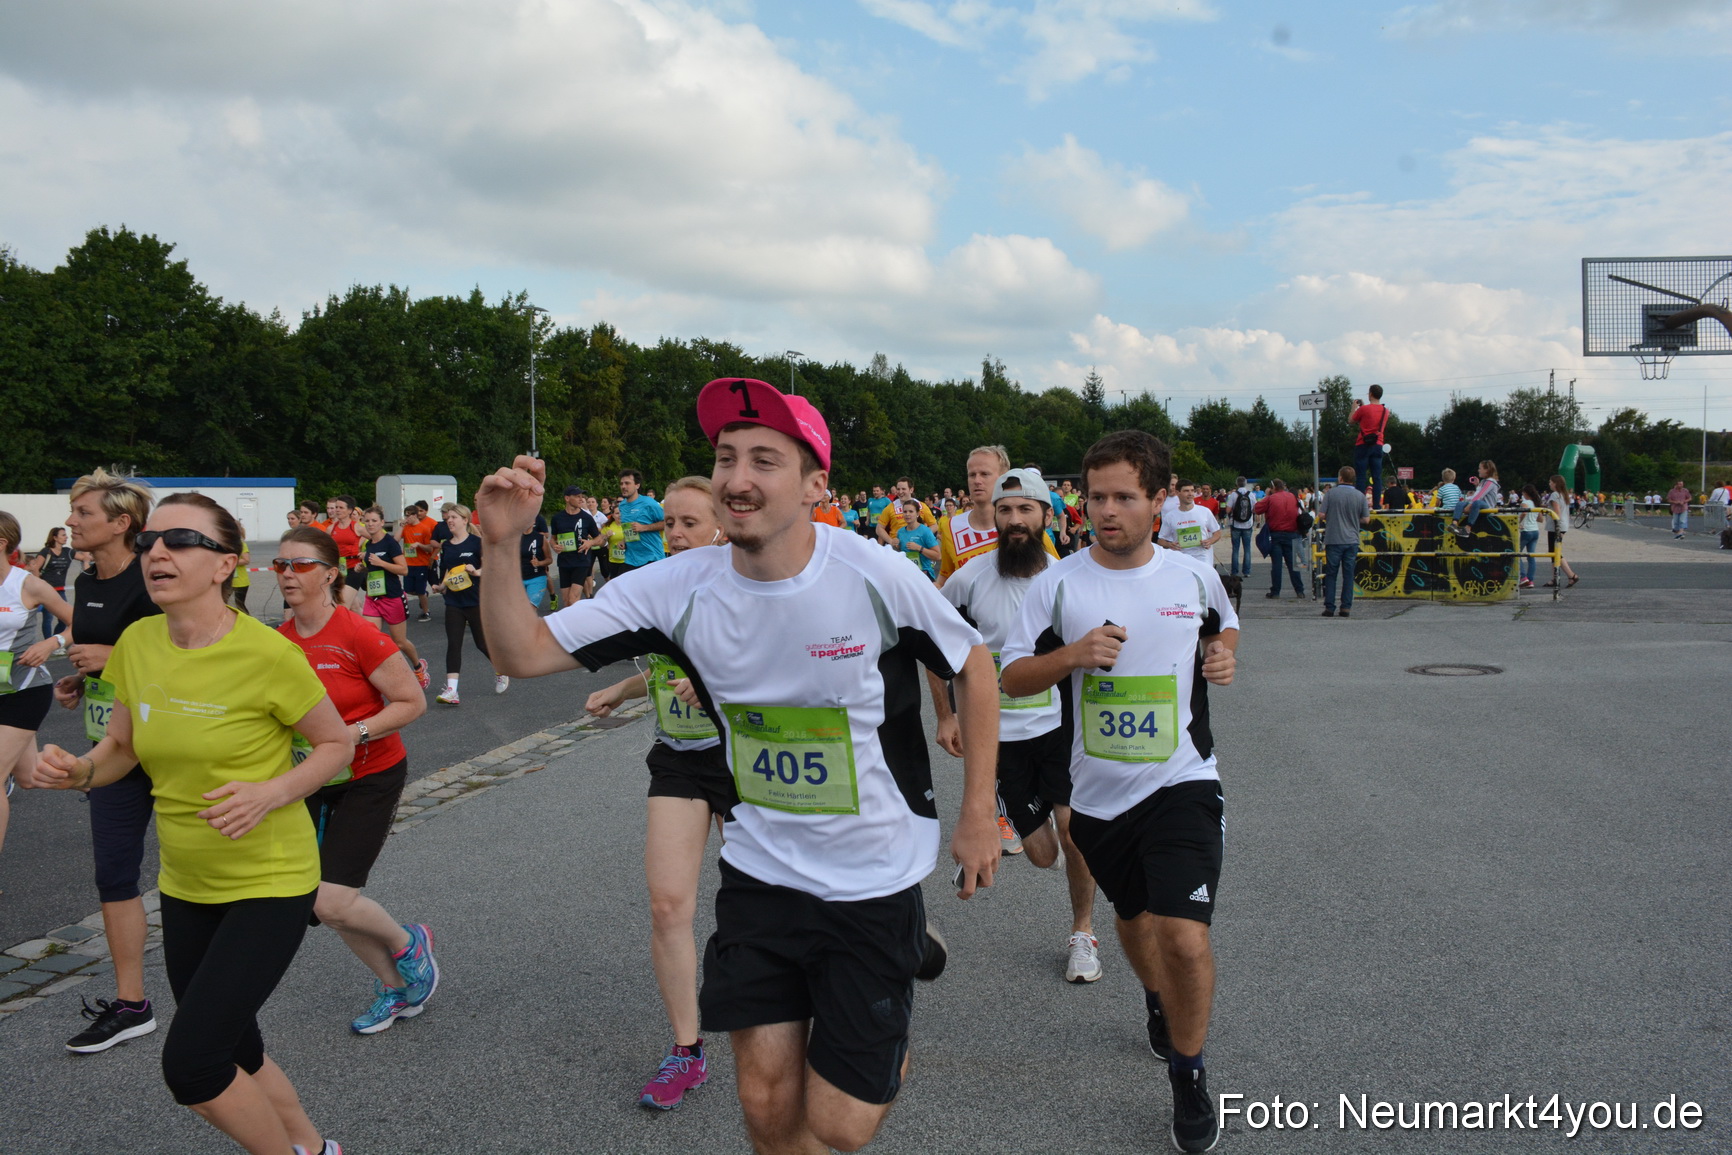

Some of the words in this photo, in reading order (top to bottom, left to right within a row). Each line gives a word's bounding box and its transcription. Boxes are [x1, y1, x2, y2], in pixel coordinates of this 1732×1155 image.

[729, 379, 761, 419] 1
[1301, 398, 1313, 406] WC
[1182, 534, 1198, 543] 544
[369, 580, 381, 589] 685
[448, 574, 465, 586] 725
[830, 635, 853, 644] TEAM
[818, 644, 867, 659] partner
[1099, 711, 1159, 739] 384
[753, 748, 829, 786] 405
[768, 789, 785, 798] Felix
[1189, 894, 1210, 903] adidas
